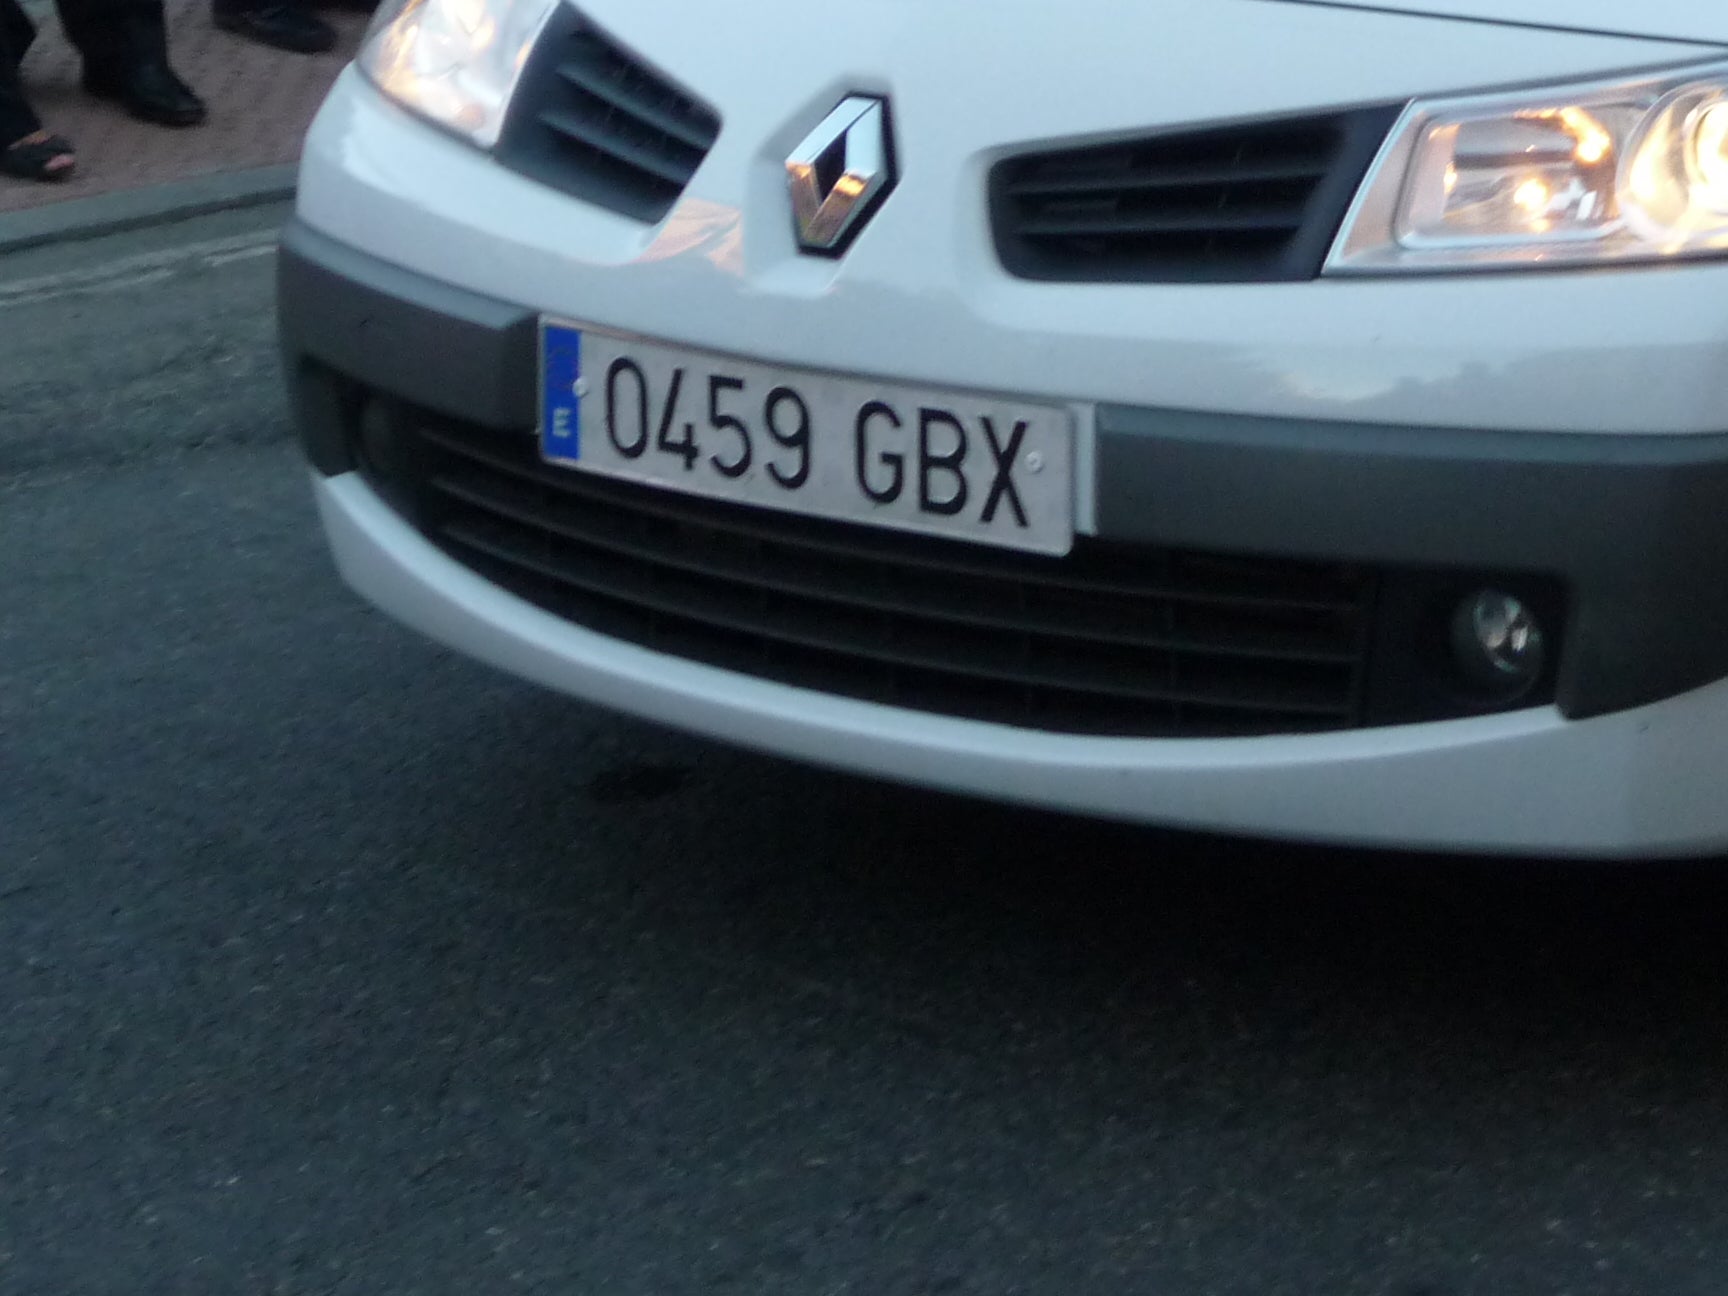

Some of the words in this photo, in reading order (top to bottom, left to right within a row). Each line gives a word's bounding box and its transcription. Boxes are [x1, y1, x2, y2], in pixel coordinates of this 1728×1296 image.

[553, 407, 571, 437] E
[605, 356, 811, 490] 0459
[855, 400, 1030, 528] GBX
